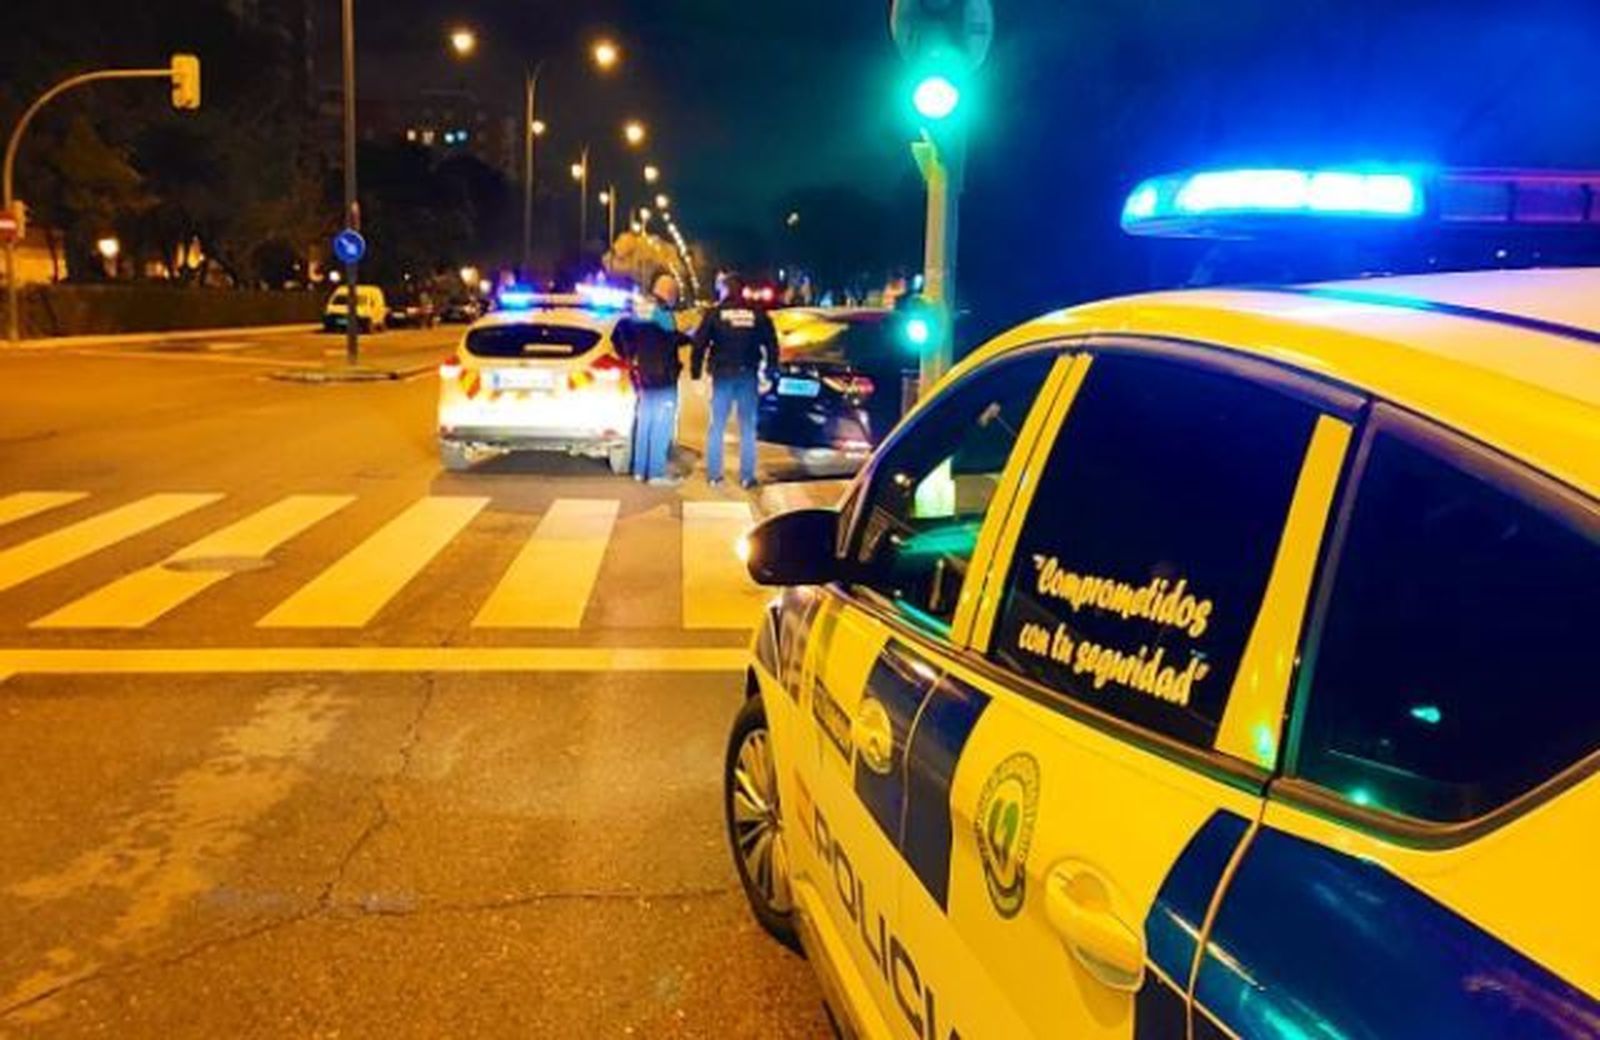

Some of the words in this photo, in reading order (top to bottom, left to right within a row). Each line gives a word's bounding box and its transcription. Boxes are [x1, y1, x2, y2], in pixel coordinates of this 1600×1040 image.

[1018, 622, 1049, 656] con
[1050, 621, 1075, 665] tu
[813, 804, 961, 1040] POLICI
